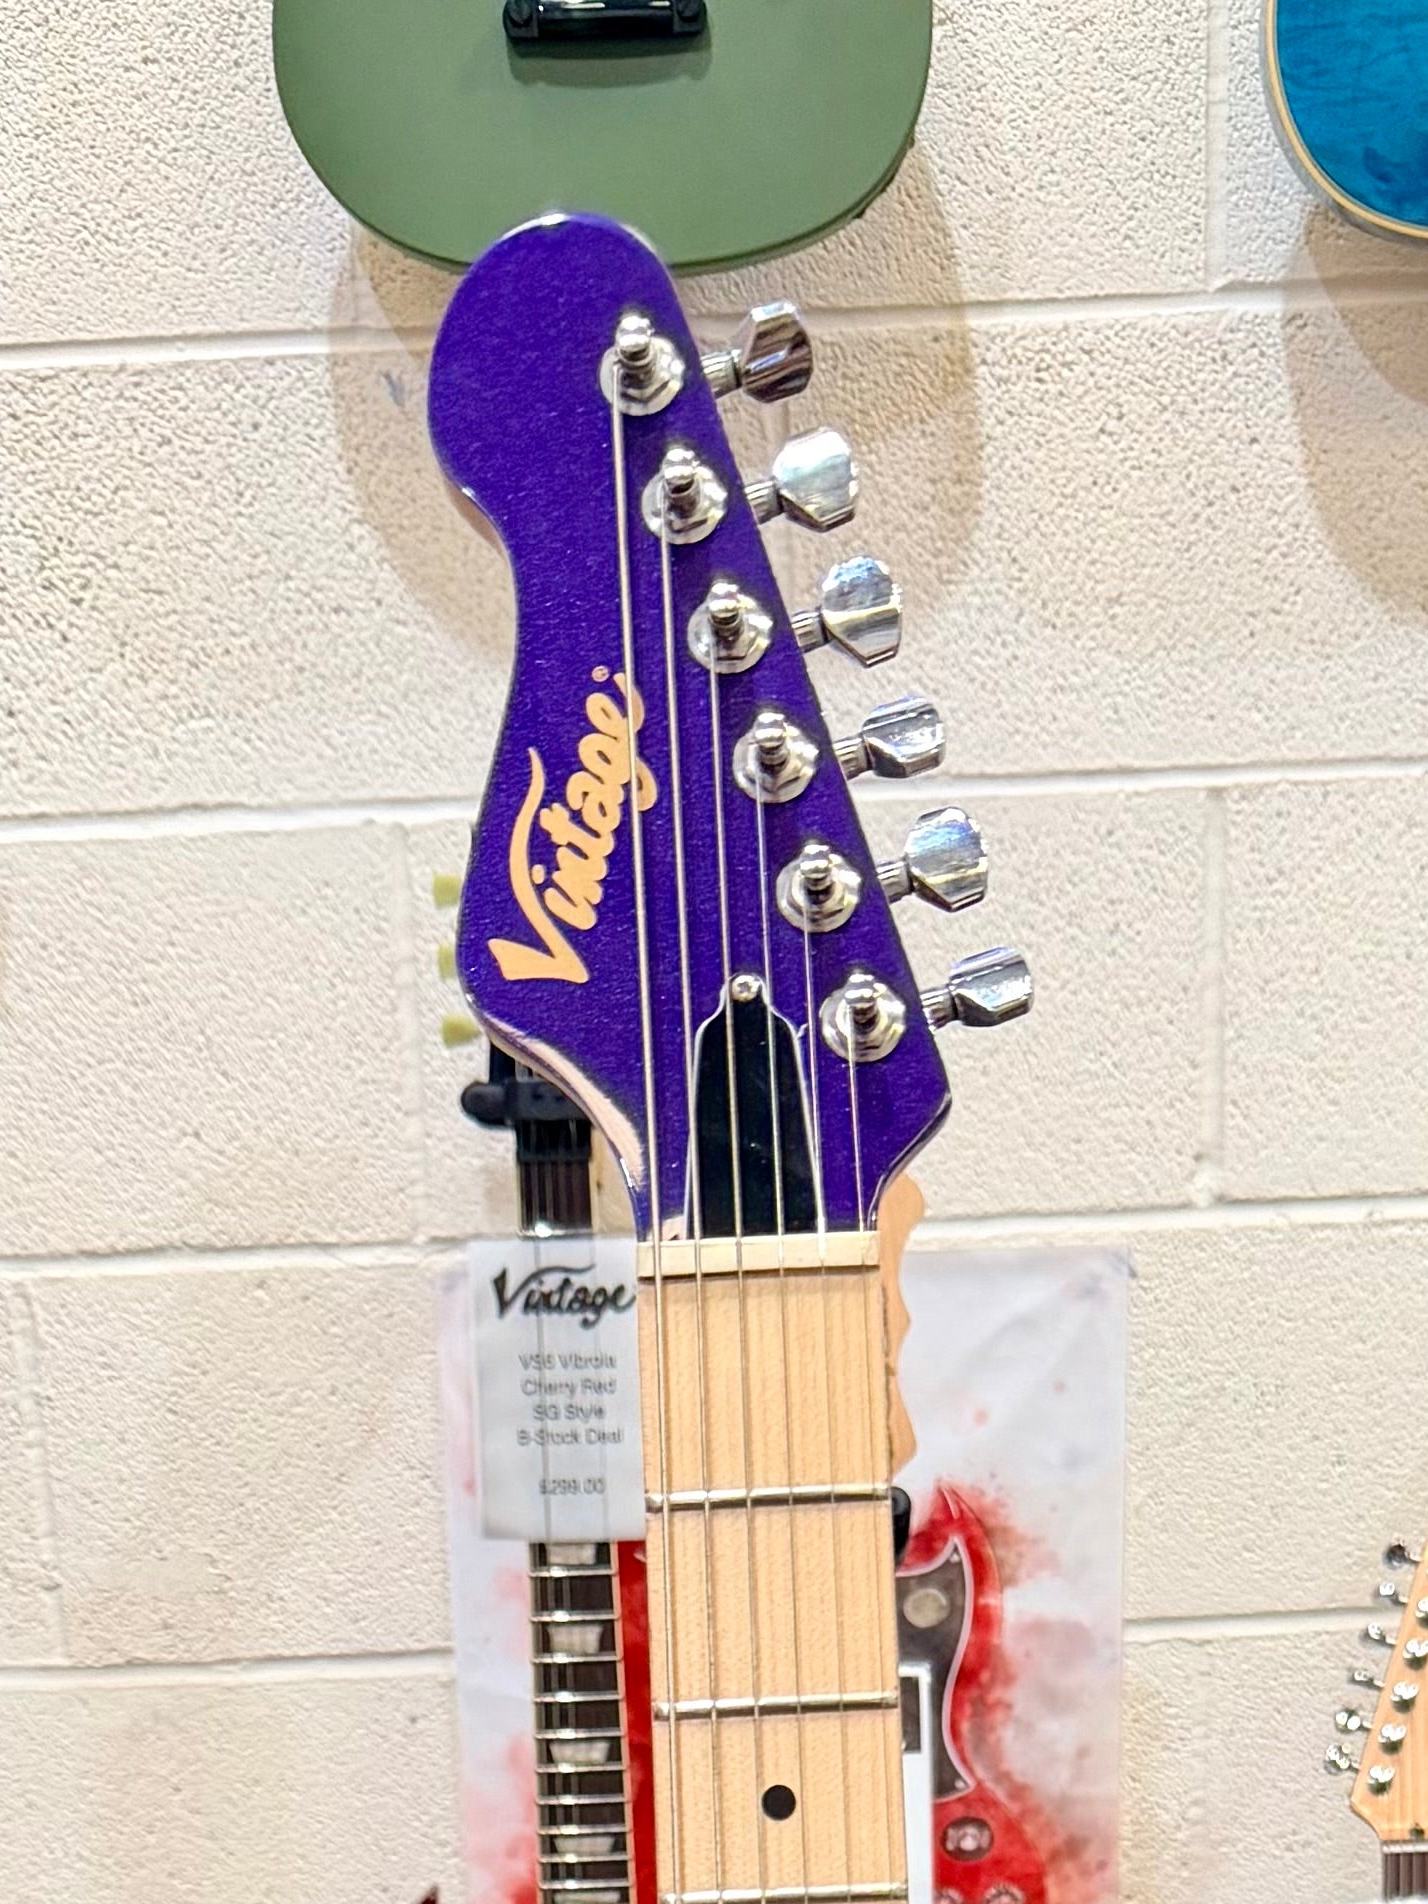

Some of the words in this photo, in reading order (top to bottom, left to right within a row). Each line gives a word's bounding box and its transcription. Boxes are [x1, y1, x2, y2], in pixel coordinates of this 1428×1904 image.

[487, 668, 658, 984] Vintage
[491, 1263, 637, 1330] Vintage
[581, 1378, 616, 1394] Red
[564, 1403, 606, 1424] Style
